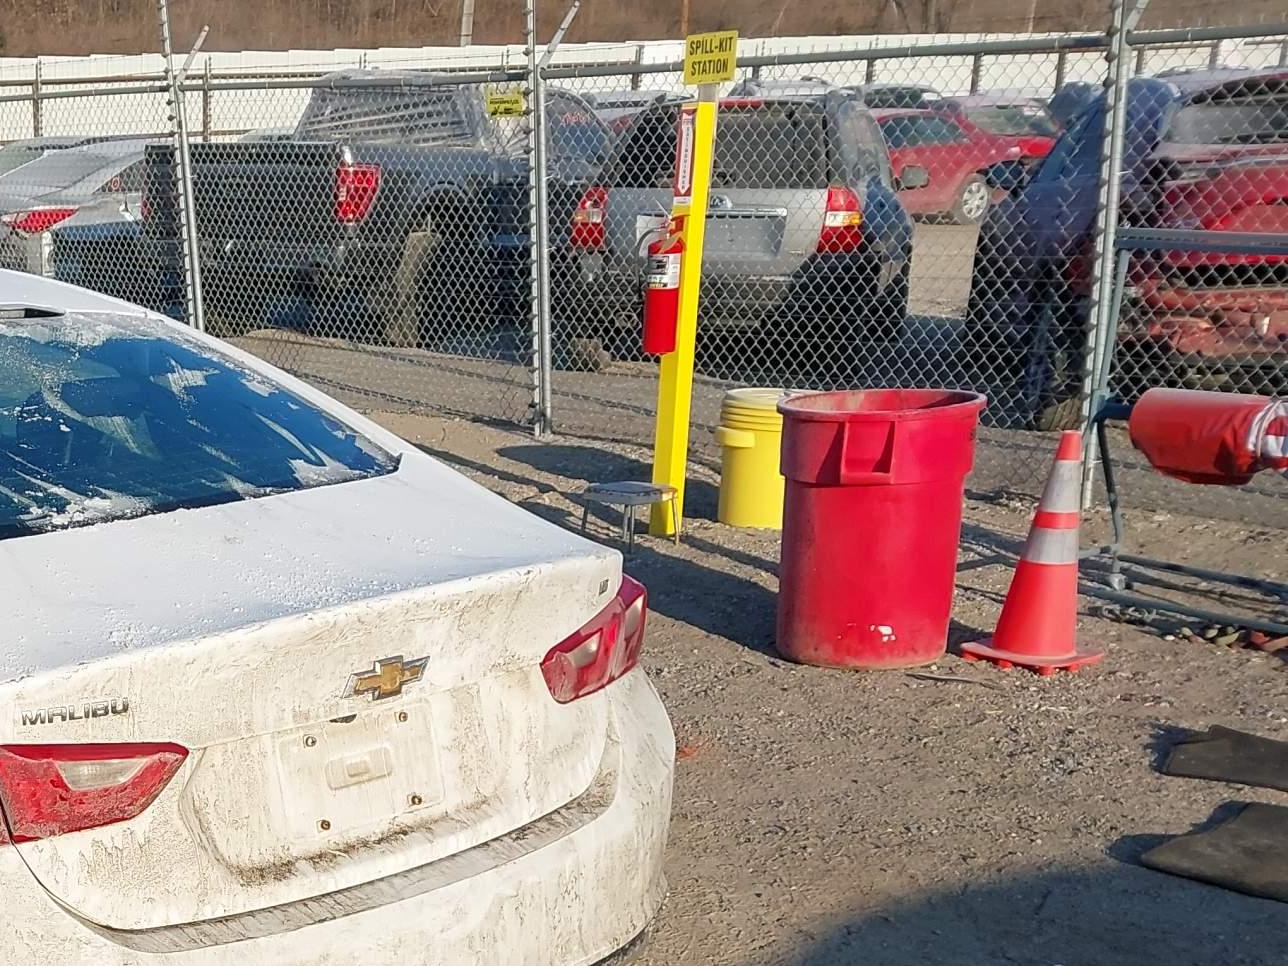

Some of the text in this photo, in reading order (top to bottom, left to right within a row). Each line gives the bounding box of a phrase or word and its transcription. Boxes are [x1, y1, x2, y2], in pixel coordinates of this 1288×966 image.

[689, 36, 734, 56] SPILL-KIT
[691, 58, 729, 76] STATION
[21, 697, 130, 725] MALIBU
